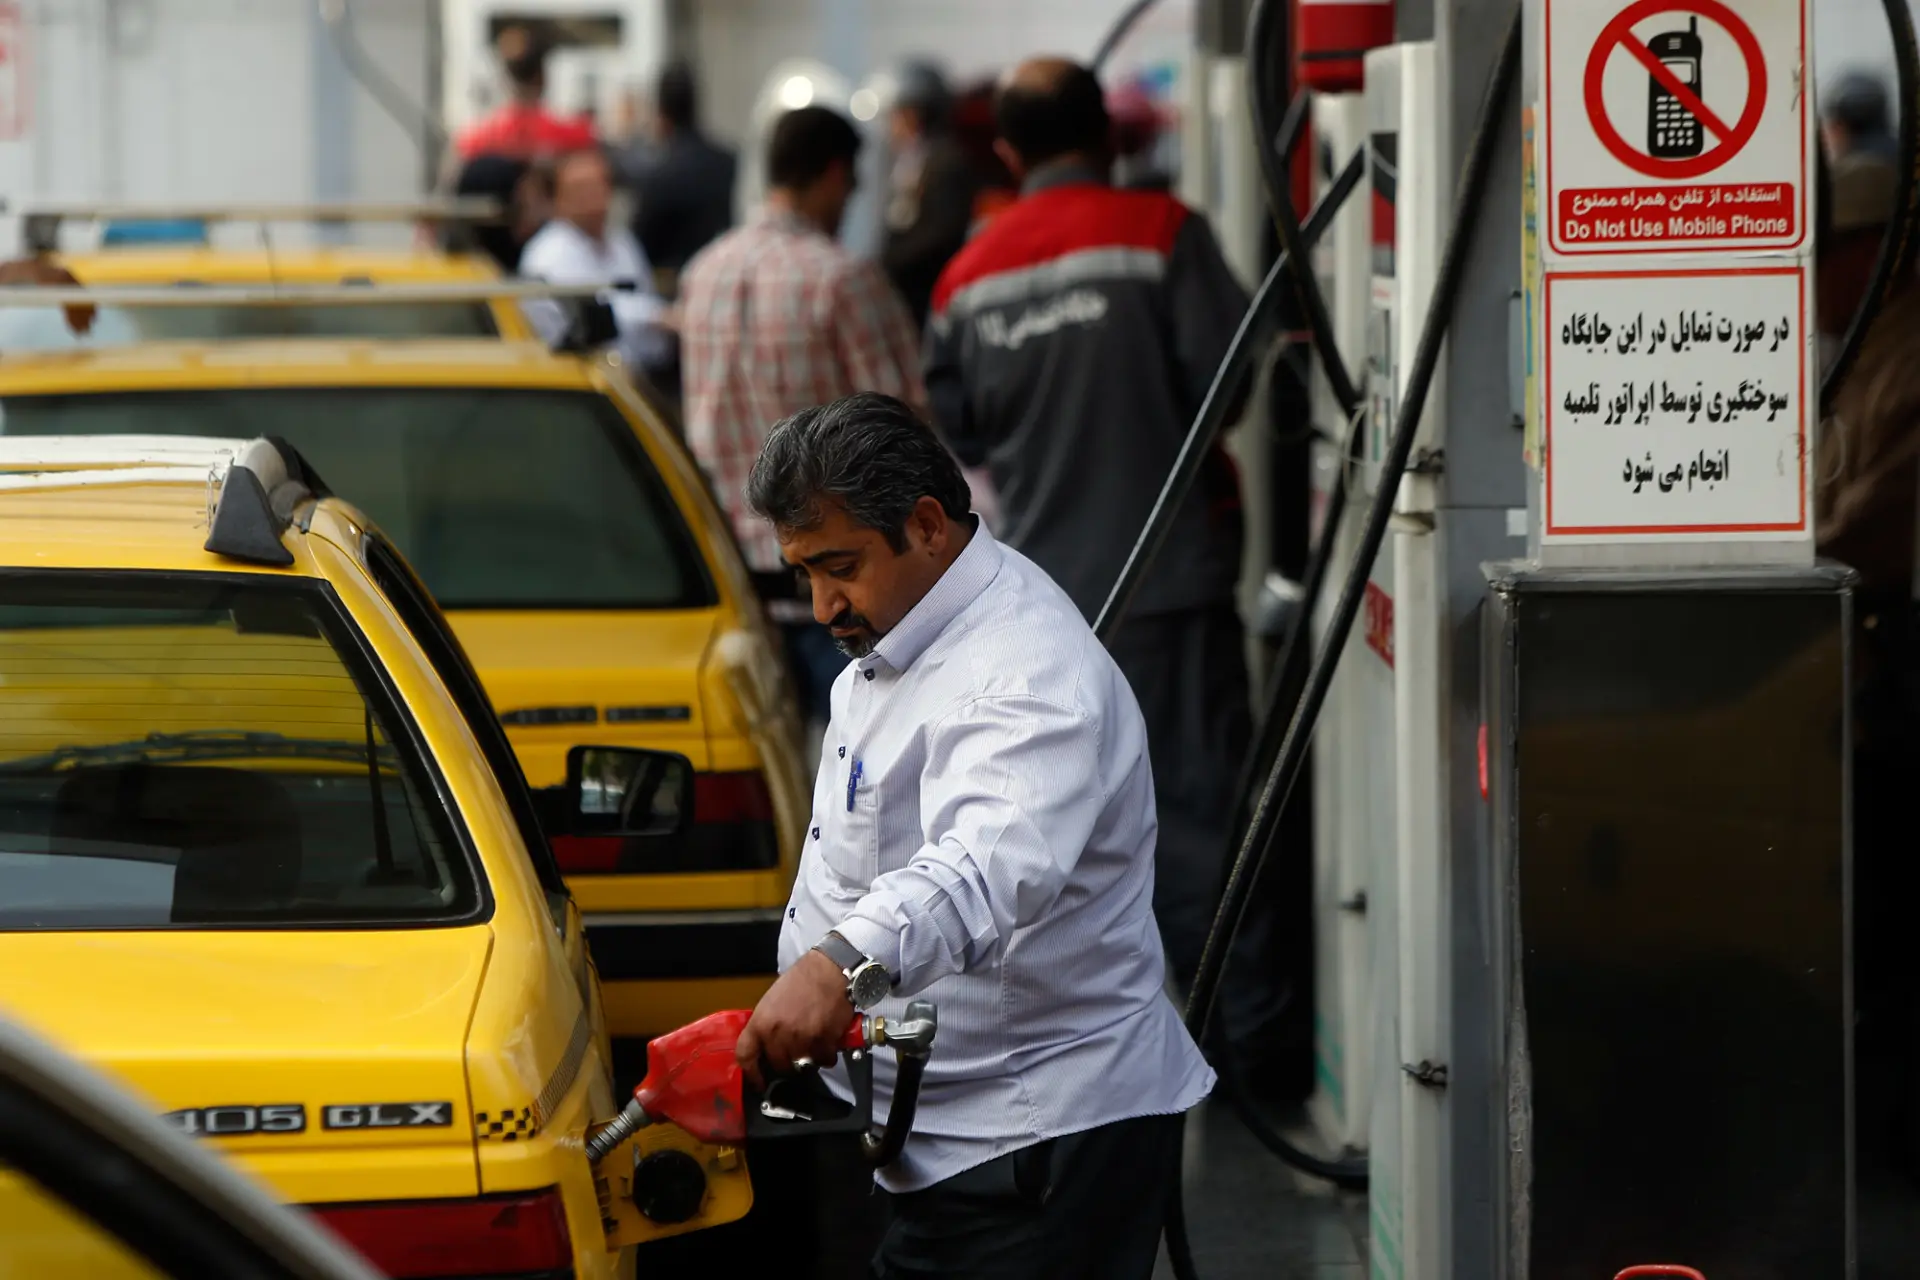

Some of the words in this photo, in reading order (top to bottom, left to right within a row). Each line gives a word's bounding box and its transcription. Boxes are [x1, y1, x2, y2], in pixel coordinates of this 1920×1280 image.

[1572, 194, 1618, 215] ممنوع
[1621, 190, 1666, 211] همراه
[1669, 190, 1704, 211] تلفن
[1707, 188, 1721, 208] از
[1724, 186, 1781, 204] استفاده
[1565, 220, 1590, 239] Do
[1595, 219, 1626, 238] Not
[1630, 217, 1663, 237] Use
[1668, 216, 1726, 236] Mobile
[1731, 214, 1788, 234] Phone
[1562, 312, 1612, 354] جایگاه
[1617, 312, 1643, 354] این
[1647, 318, 1667, 354] در
[1671, 311, 1713, 352] تمایل
[1716, 317, 1766, 353] صورت
[1769, 316, 1790, 352] در
[1563, 382, 1600, 423] تلمبه
[1604, 381, 1655, 425] اپراتور
[1660, 380, 1703, 423] توسط
[1707, 379, 1789, 423] سوختگیری
[1623, 451, 1655, 494] شود
[1658, 462, 1683, 493] می
[1688, 449, 1729, 492] انجام
[166, 1105, 304, 1133] 405
[327, 1103, 446, 1128] GLX
